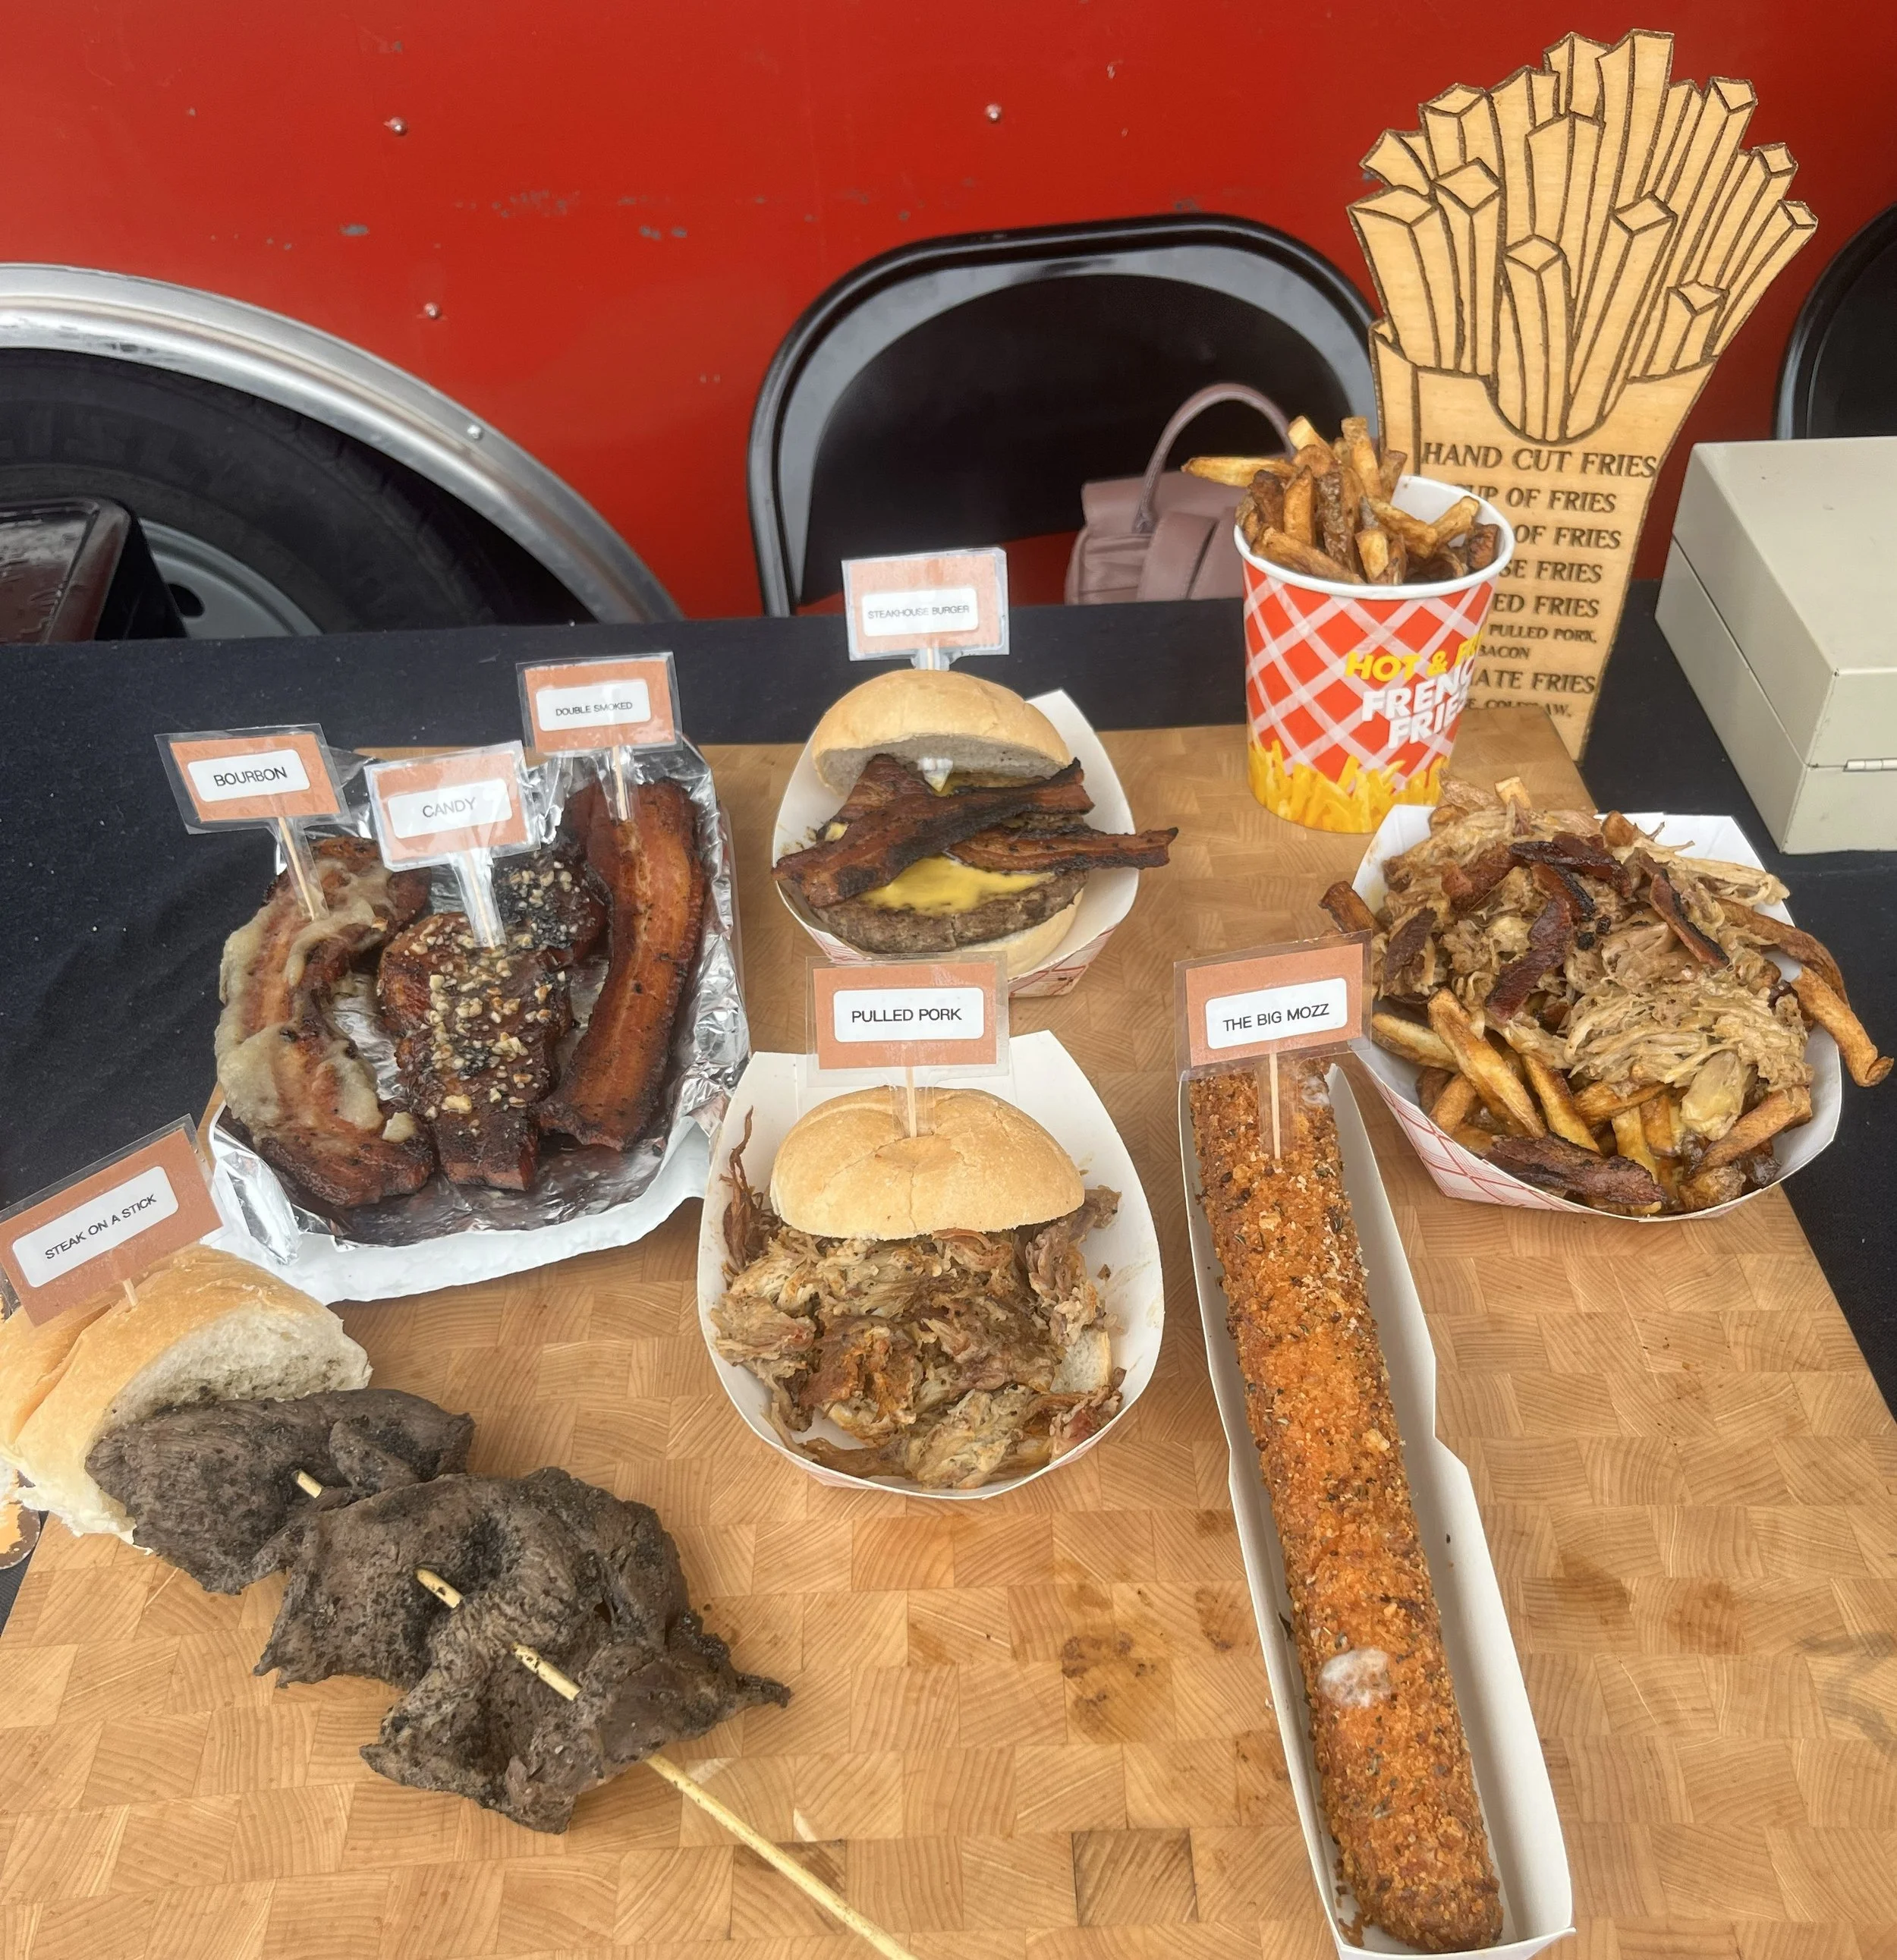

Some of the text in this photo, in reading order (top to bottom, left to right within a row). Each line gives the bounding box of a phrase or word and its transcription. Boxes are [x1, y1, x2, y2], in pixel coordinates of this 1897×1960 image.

[1420, 442, 1658, 478] HAND CUT FRIES
[1505, 487, 1540, 508] OF
[1547, 490, 1617, 513] FRIES
[1514, 524, 1621, 549] OF FRIES
[1534, 561, 1603, 584] FRIES
[868, 606, 970, 619] STEAKHOUSE BURGER
[1533, 596, 1600, 618] FRIES
[1488, 624, 1548, 639] PULLED
[1345, 652, 1420, 681] HOT
[1427, 651, 1448, 676] &
[1361, 656, 1474, 722] FRENC
[1471, 668, 1596, 694] ATE FRIES
[555, 702, 633, 716] DOUBLE SMOKED
[213, 766, 288, 788] BOURBON
[422, 797, 477, 819] CANDY
[851, 1008, 962, 1023] PULLED PORK
[1223, 1003, 1330, 1032] THE BIG MOZZ
[45, 1194, 157, 1260] STEAK ON A STICK
